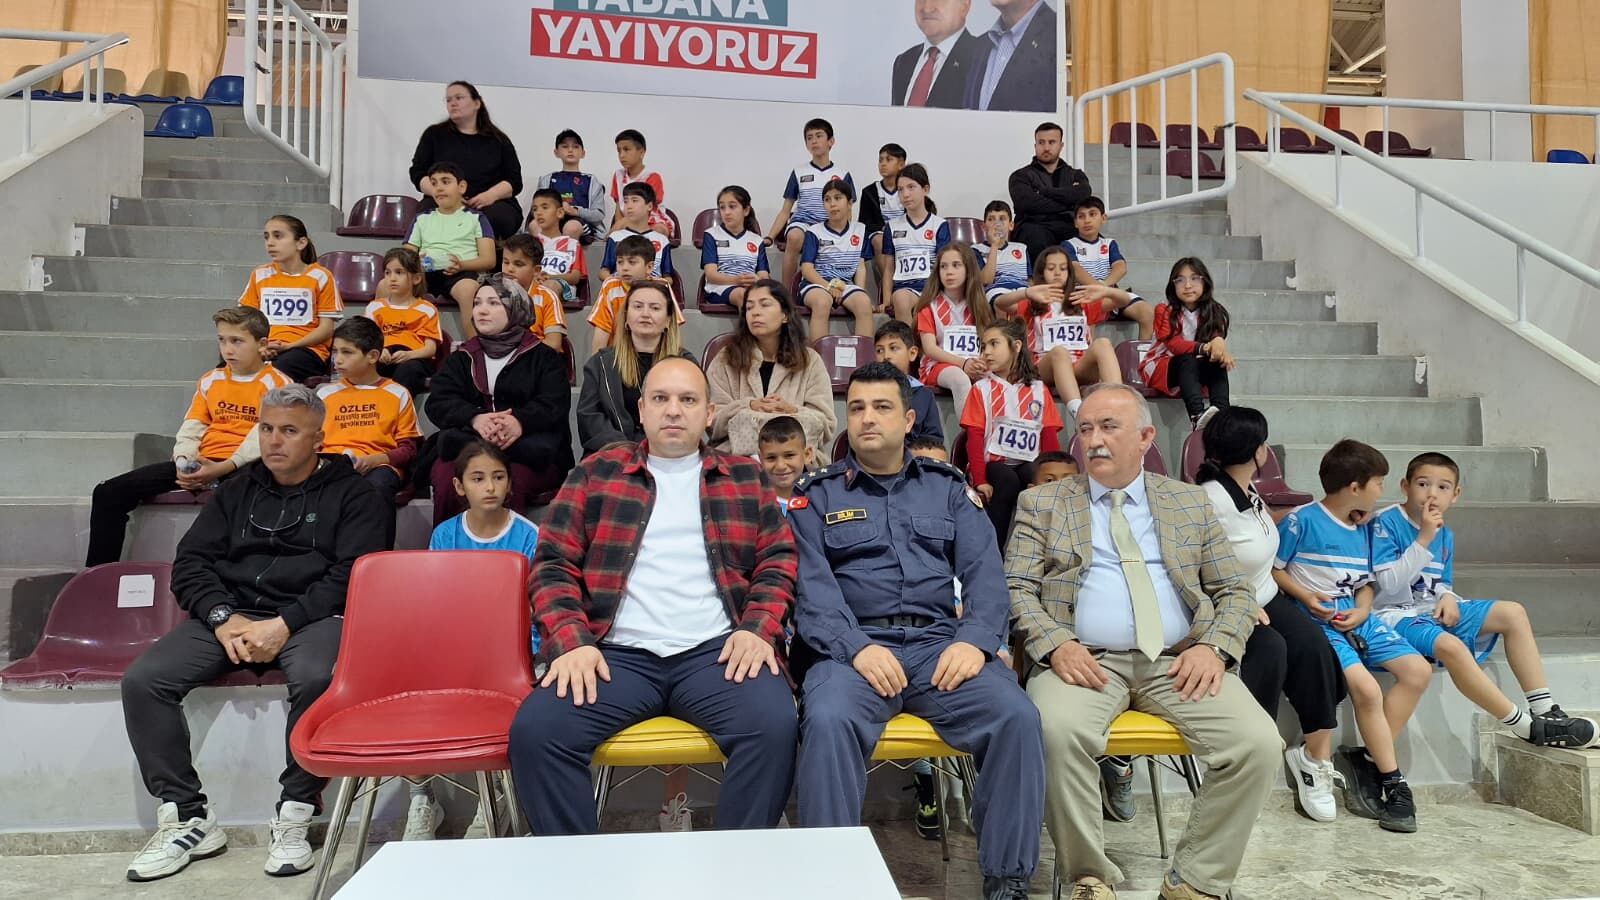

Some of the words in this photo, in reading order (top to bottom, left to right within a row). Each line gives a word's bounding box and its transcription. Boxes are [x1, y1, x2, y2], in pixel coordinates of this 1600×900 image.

[538, 13, 811, 74] YAYIYORUZ
[540, 256, 567, 274] 446
[899, 256, 927, 274] 1373
[264, 297, 309, 317] 1299
[1047, 324, 1084, 344] 1452
[997, 425, 1037, 452] 1430
